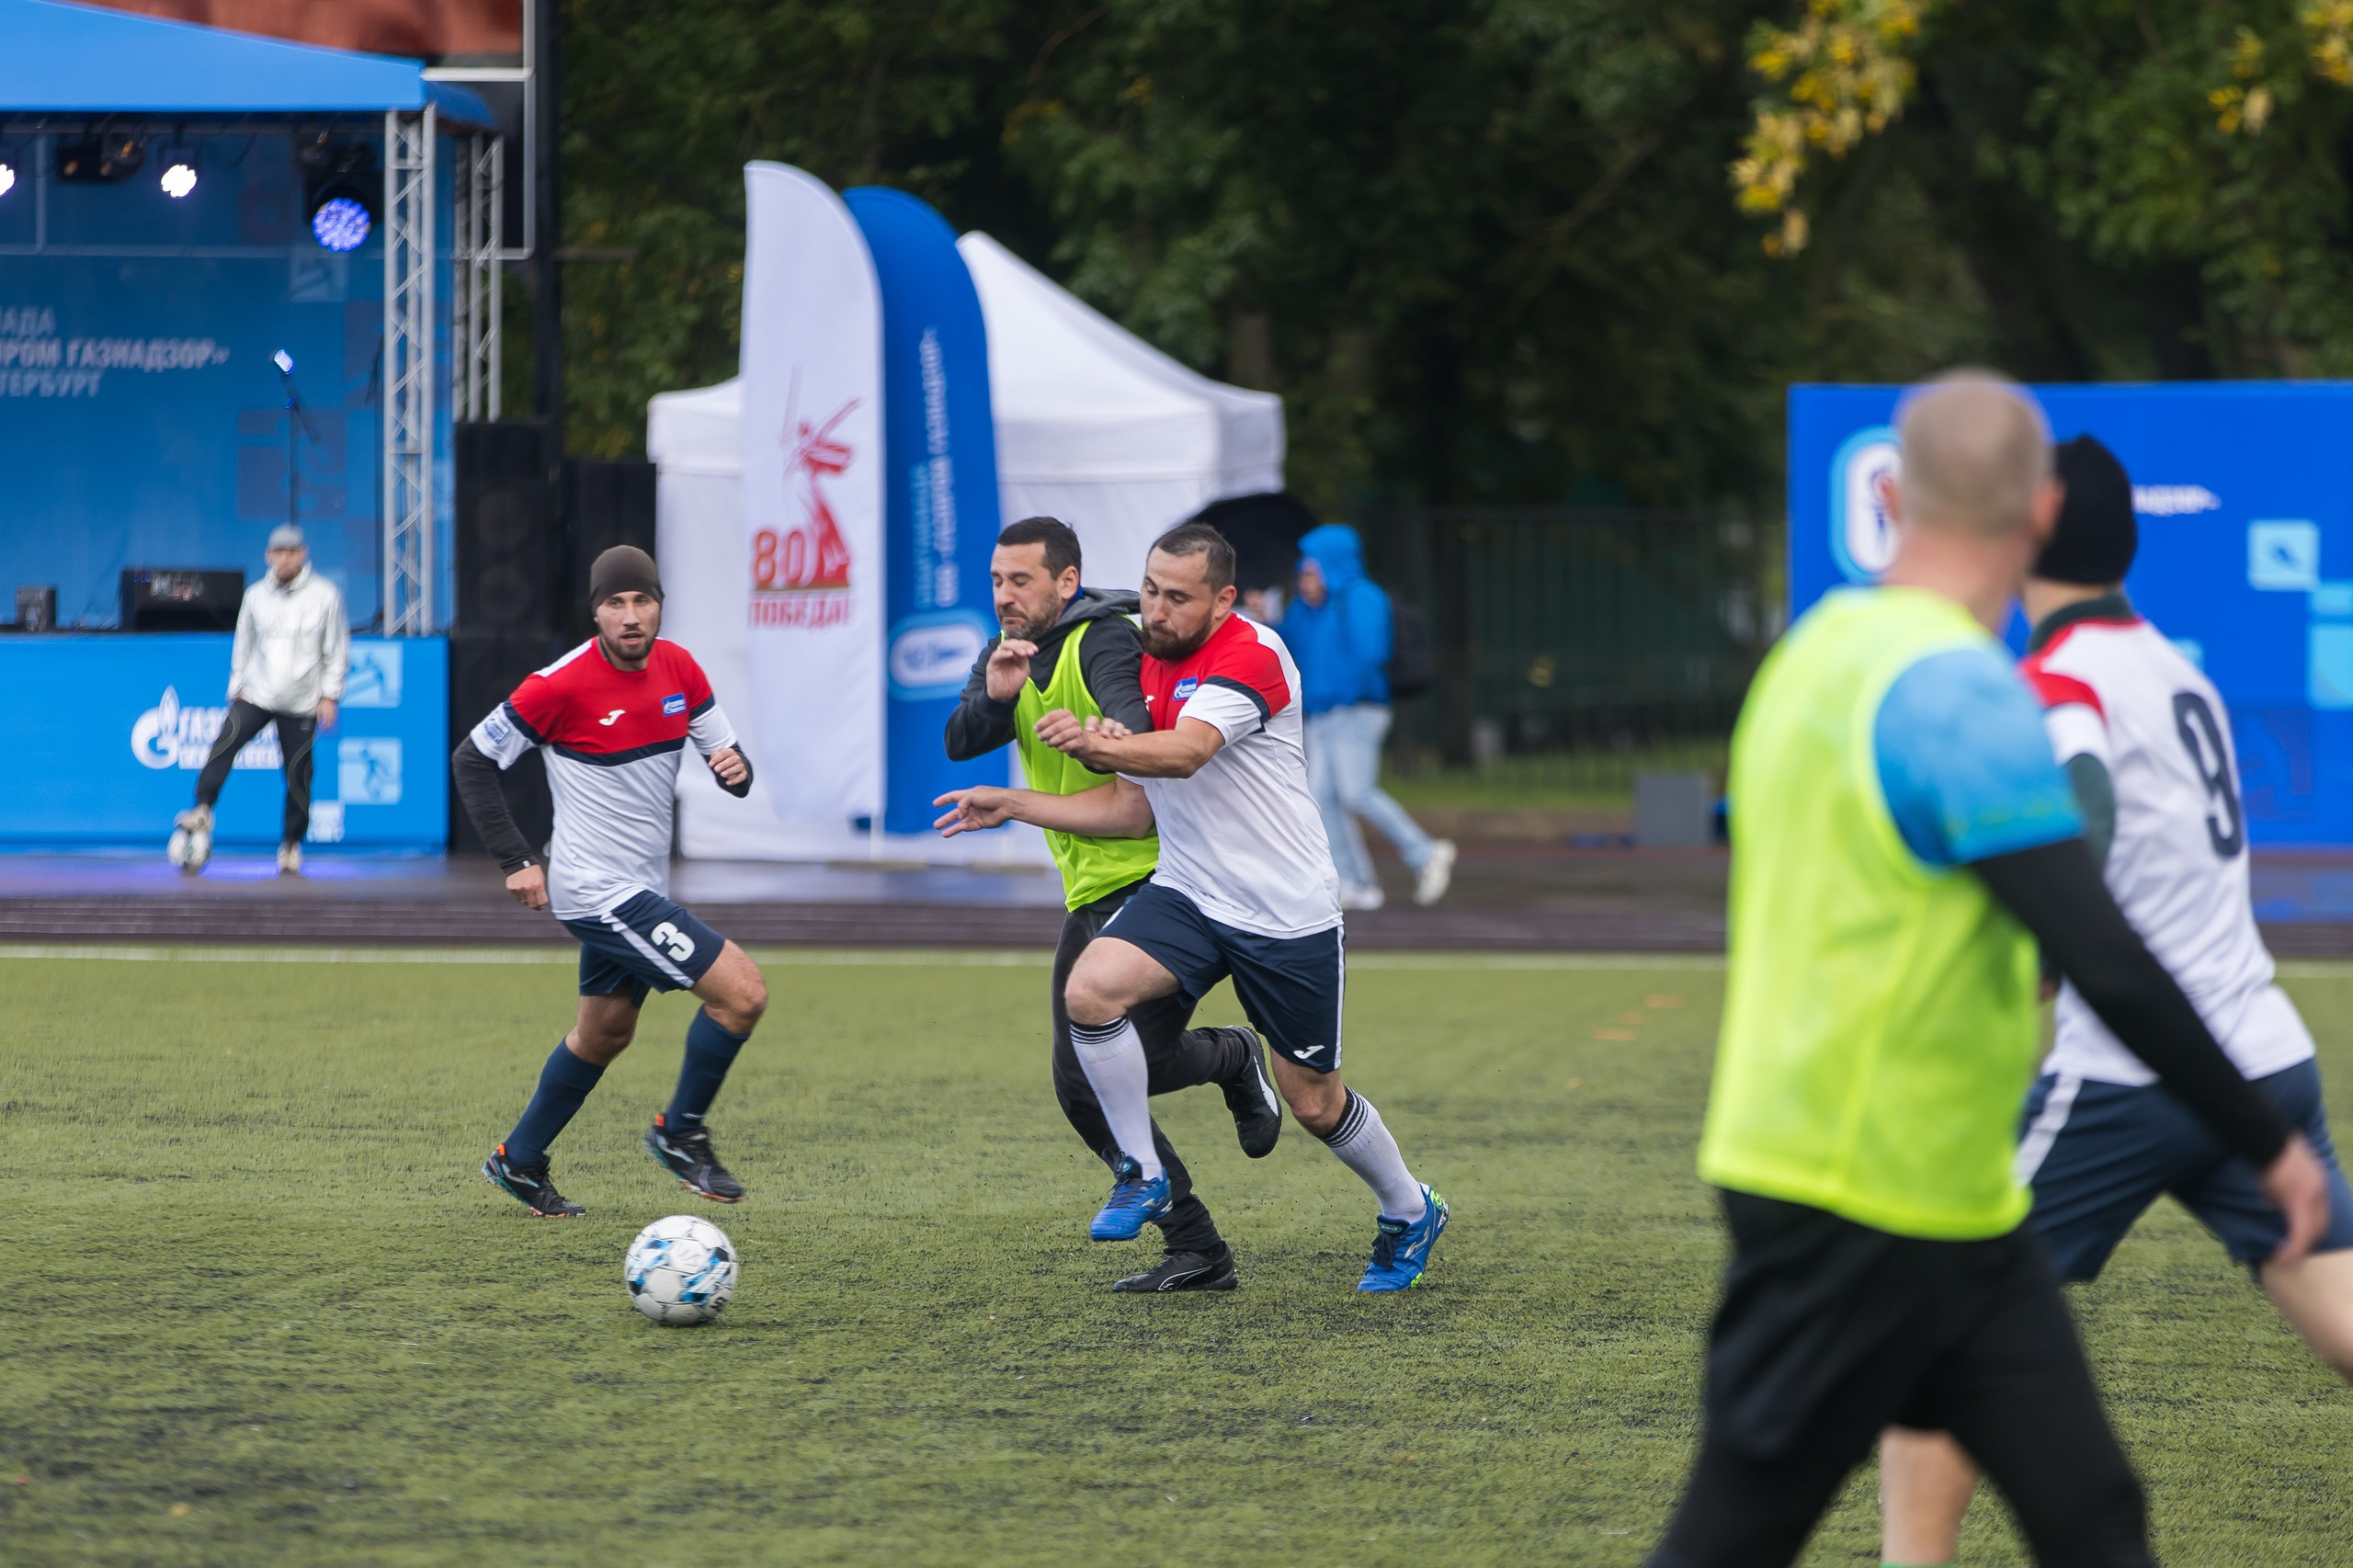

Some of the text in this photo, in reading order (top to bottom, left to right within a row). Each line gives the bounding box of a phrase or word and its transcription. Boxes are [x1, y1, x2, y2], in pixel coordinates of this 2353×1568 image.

[0, 307, 56, 336] АДА
[0, 337, 230, 372] РОМ ГАЗНАДЗОР»
[752, 529, 806, 589] 80
[2172, 692, 2243, 857] 9
[651, 922, 696, 962] 3
